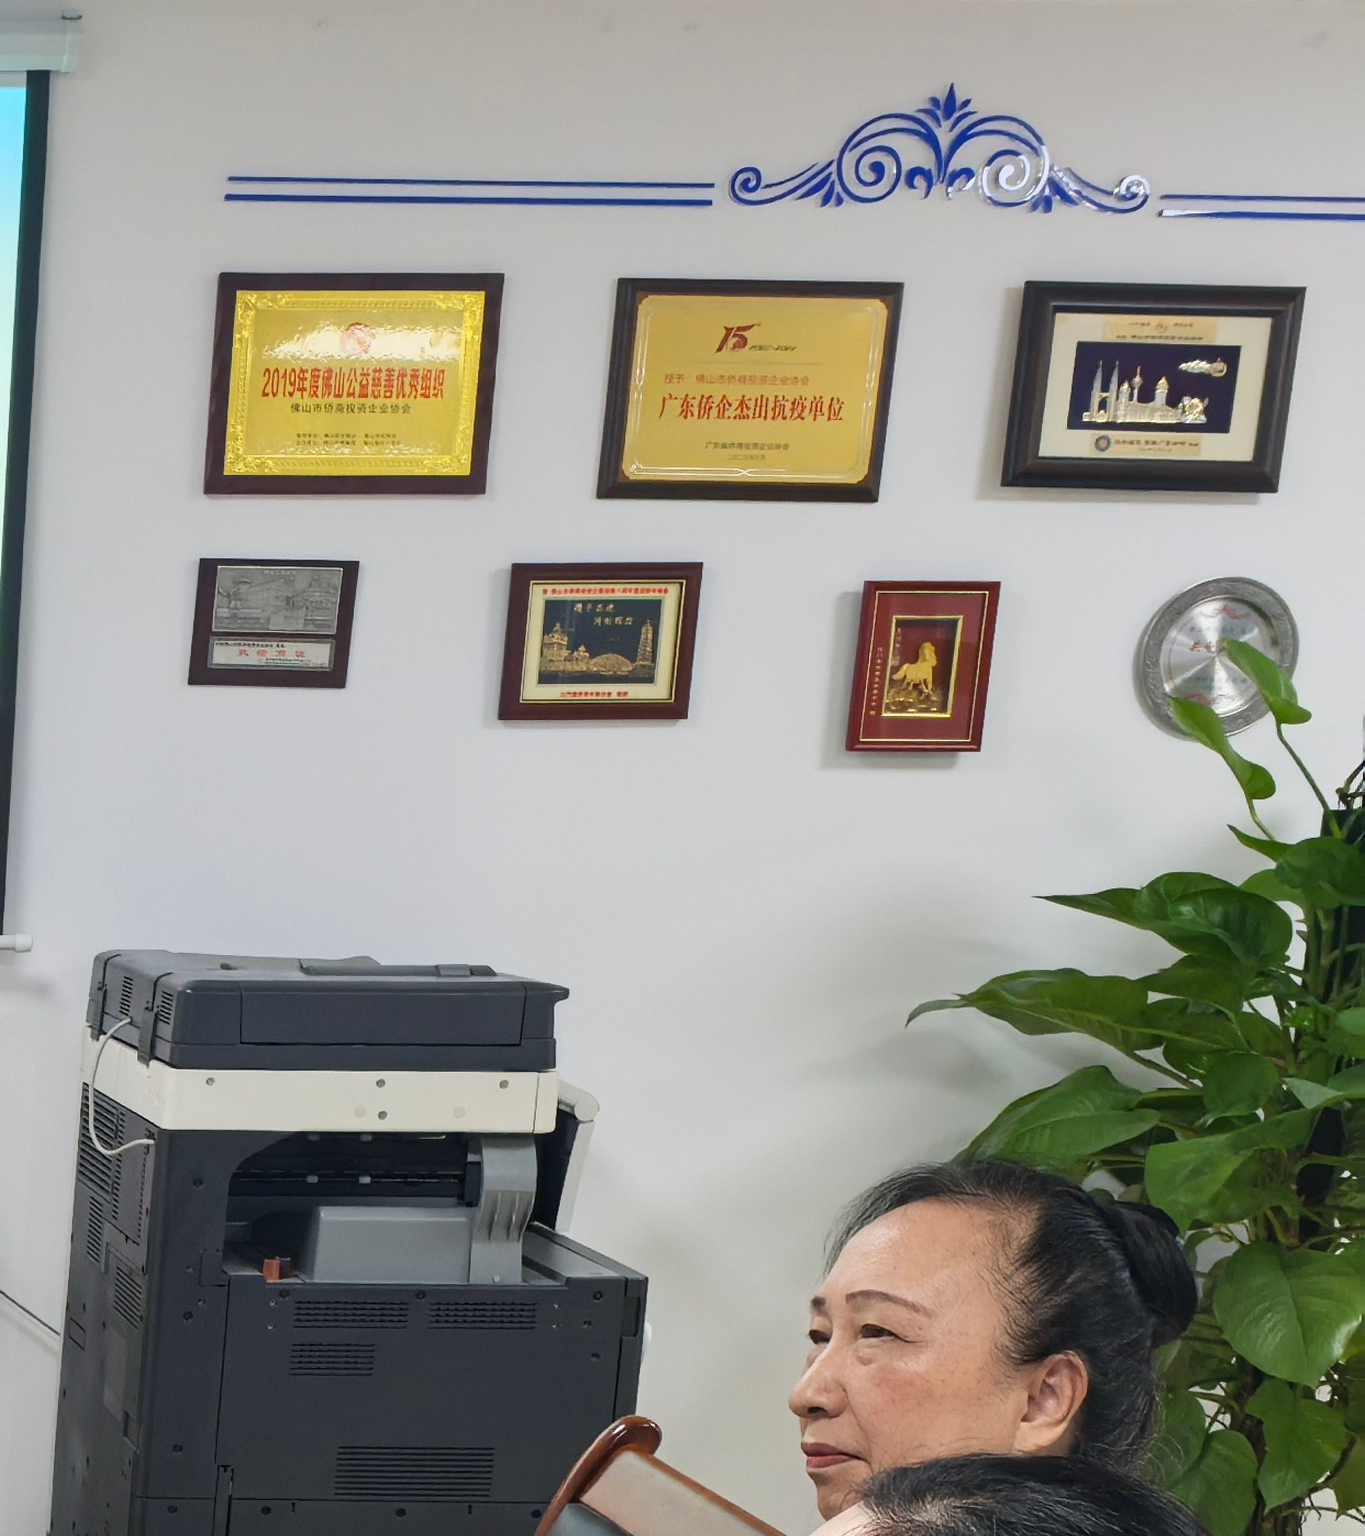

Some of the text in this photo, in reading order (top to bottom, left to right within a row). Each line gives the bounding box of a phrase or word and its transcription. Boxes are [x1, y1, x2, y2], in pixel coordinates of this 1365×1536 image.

[261, 366, 446, 400] 2019年度佛山公益慈善优秀组织
[658, 393, 845, 423] 广东侨企杰出抗疫单位
